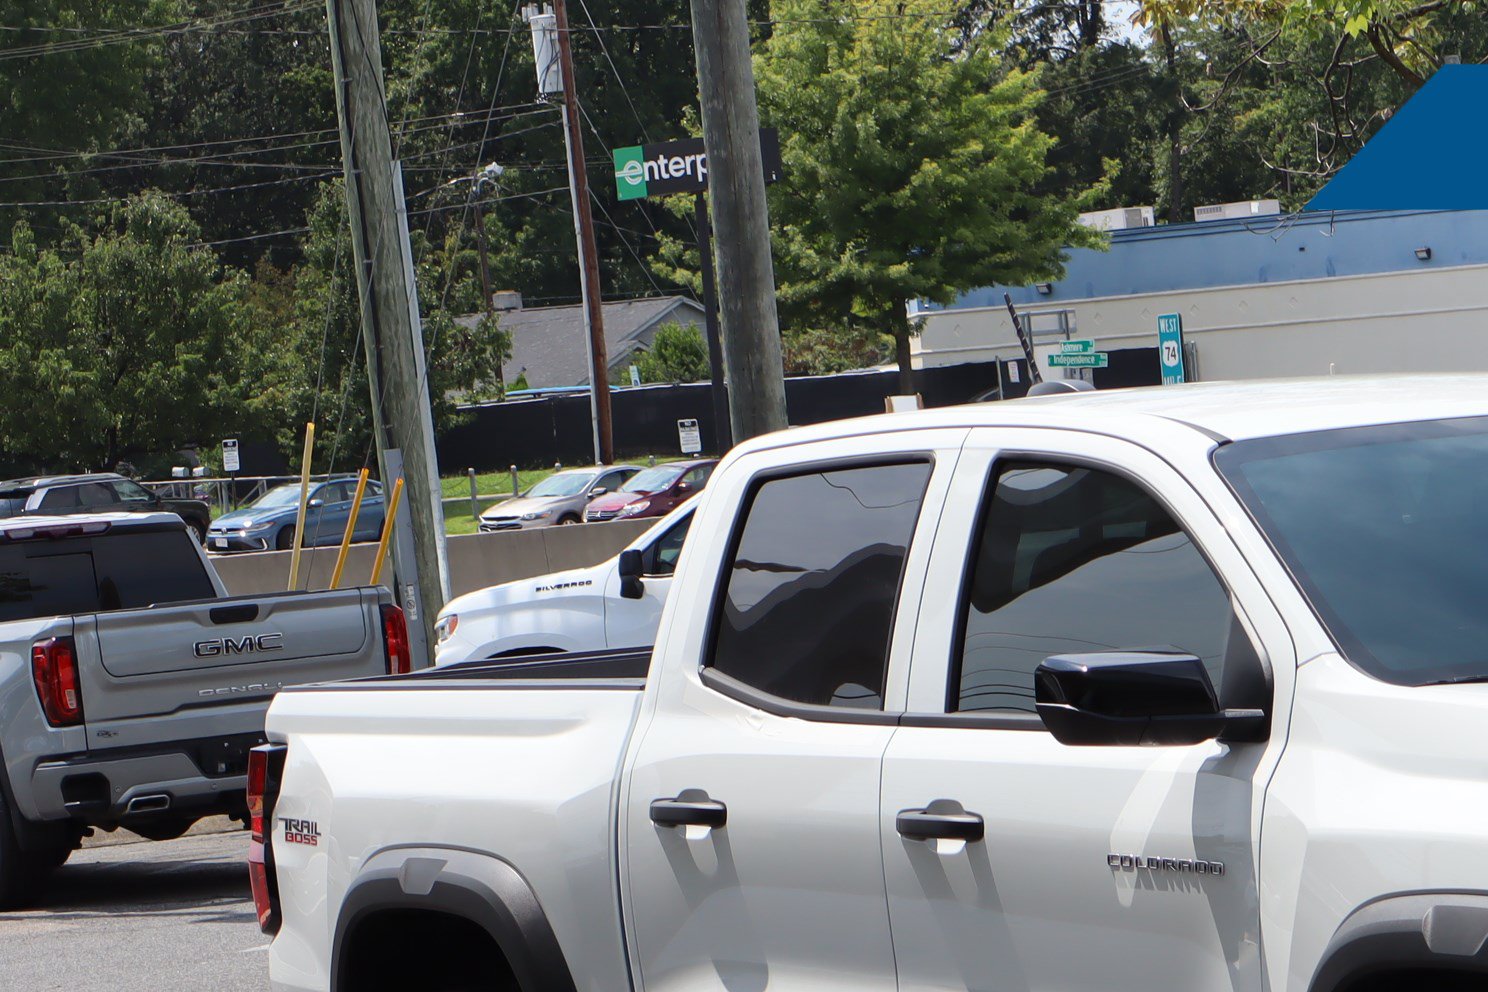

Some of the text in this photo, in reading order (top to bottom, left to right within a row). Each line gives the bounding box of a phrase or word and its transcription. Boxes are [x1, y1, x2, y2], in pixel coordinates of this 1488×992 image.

[615, 153, 708, 185] enterp
[1159, 318, 1177, 333] WEST
[1053, 355, 1096, 366] Independence
[1165, 346, 1177, 361] 74
[535, 580, 592, 592] SILVERADO
[193, 632, 283, 658] GMC
[278, 817, 321, 836] TRAIL
[285, 832, 317, 846] BOSS
[1107, 853, 1225, 875] COLORADO
